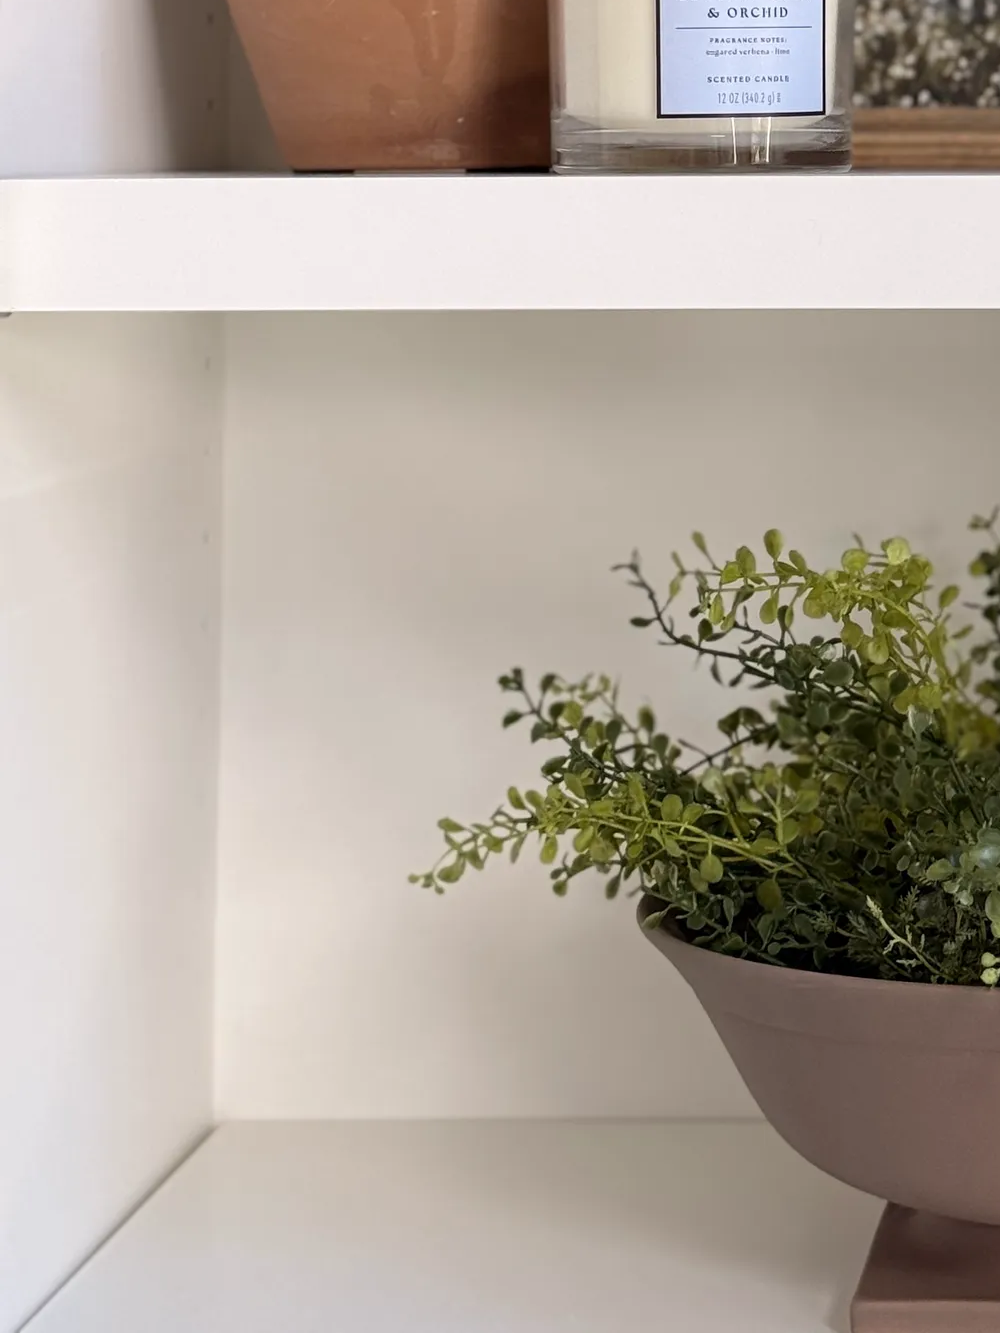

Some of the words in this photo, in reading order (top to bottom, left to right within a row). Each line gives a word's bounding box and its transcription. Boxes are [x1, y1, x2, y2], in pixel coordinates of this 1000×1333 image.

[707, 7, 720, 19] &
[727, 7, 789, 19] ORCHID
[707, 76, 751, 84] SCENTED
[754, 75, 790, 83] CANDLE
[718, 92, 727, 104] 12
[729, 92, 740, 104] OZ
